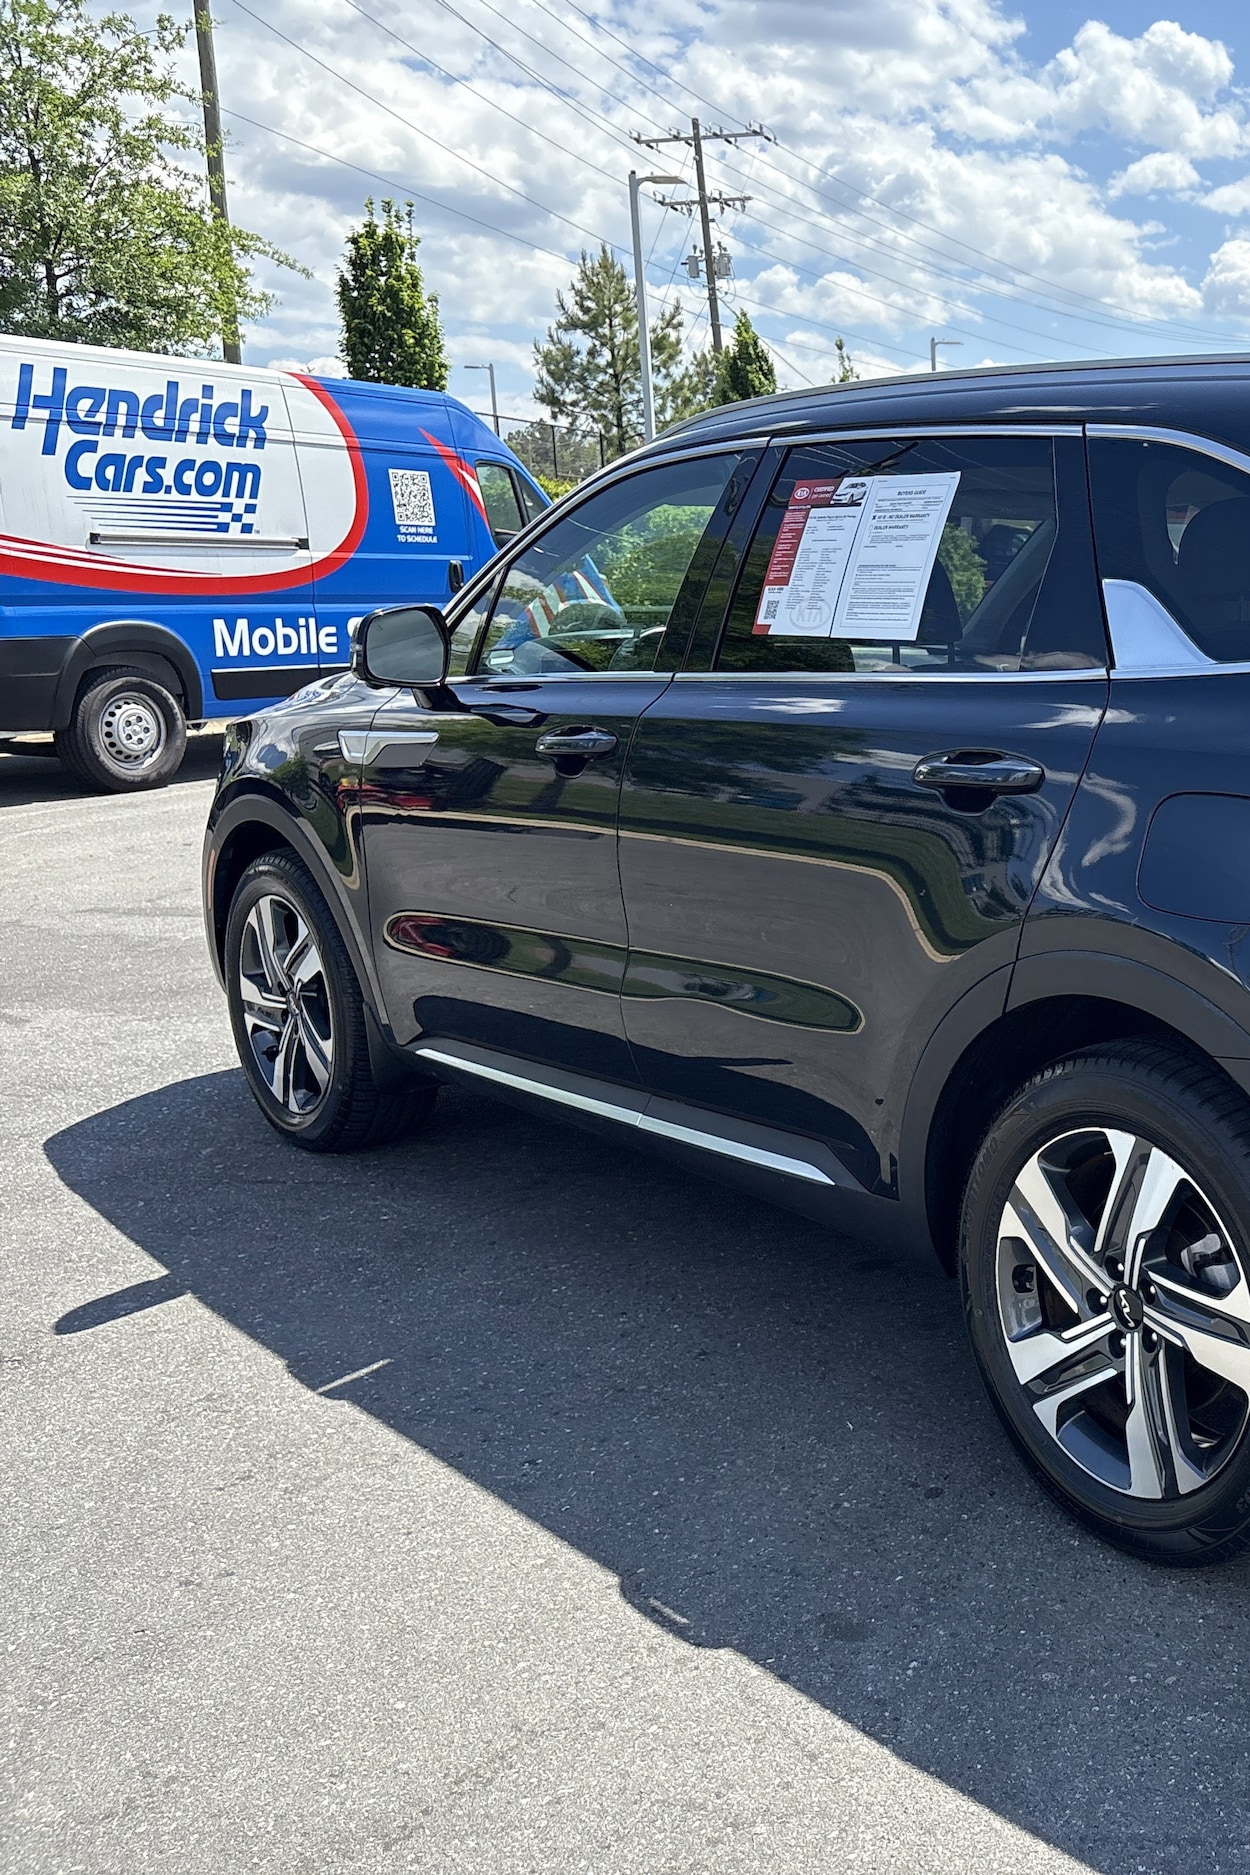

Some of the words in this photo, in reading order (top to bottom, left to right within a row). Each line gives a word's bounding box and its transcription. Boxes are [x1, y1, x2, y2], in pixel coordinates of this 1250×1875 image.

[11, 363, 269, 456] Hendrick
[64, 439, 262, 500] Cars.com
[397, 534, 406, 542] TO
[406, 535, 438, 543] SCHEDULE
[213, 617, 338, 658] Mobile
